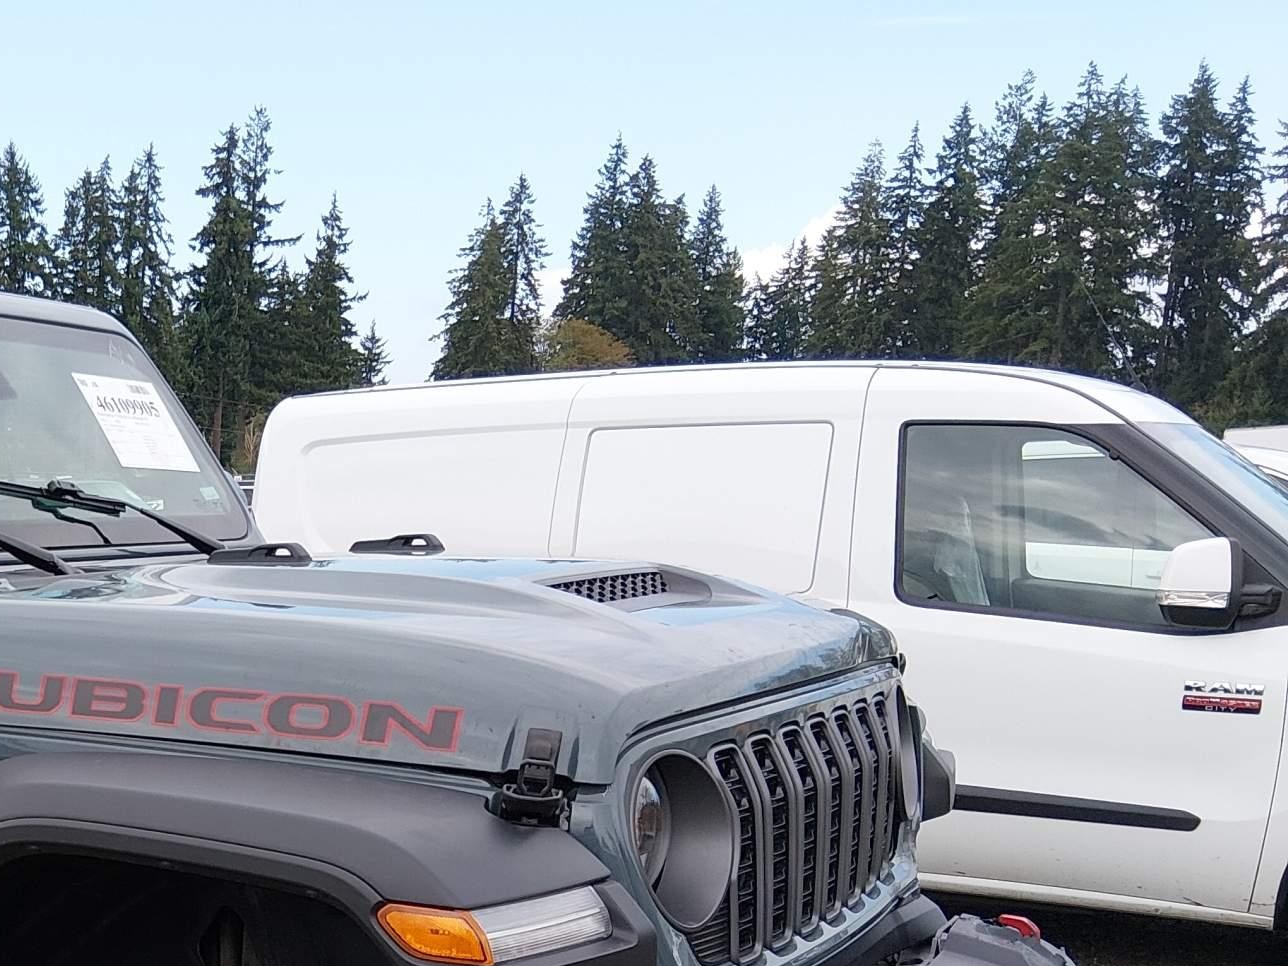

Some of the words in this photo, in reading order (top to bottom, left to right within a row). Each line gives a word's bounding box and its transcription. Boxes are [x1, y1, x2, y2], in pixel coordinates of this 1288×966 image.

[96, 395, 161, 418] 46109905
[1183, 680, 1265, 696] RAM
[1204, 705, 1237, 713] CITY
